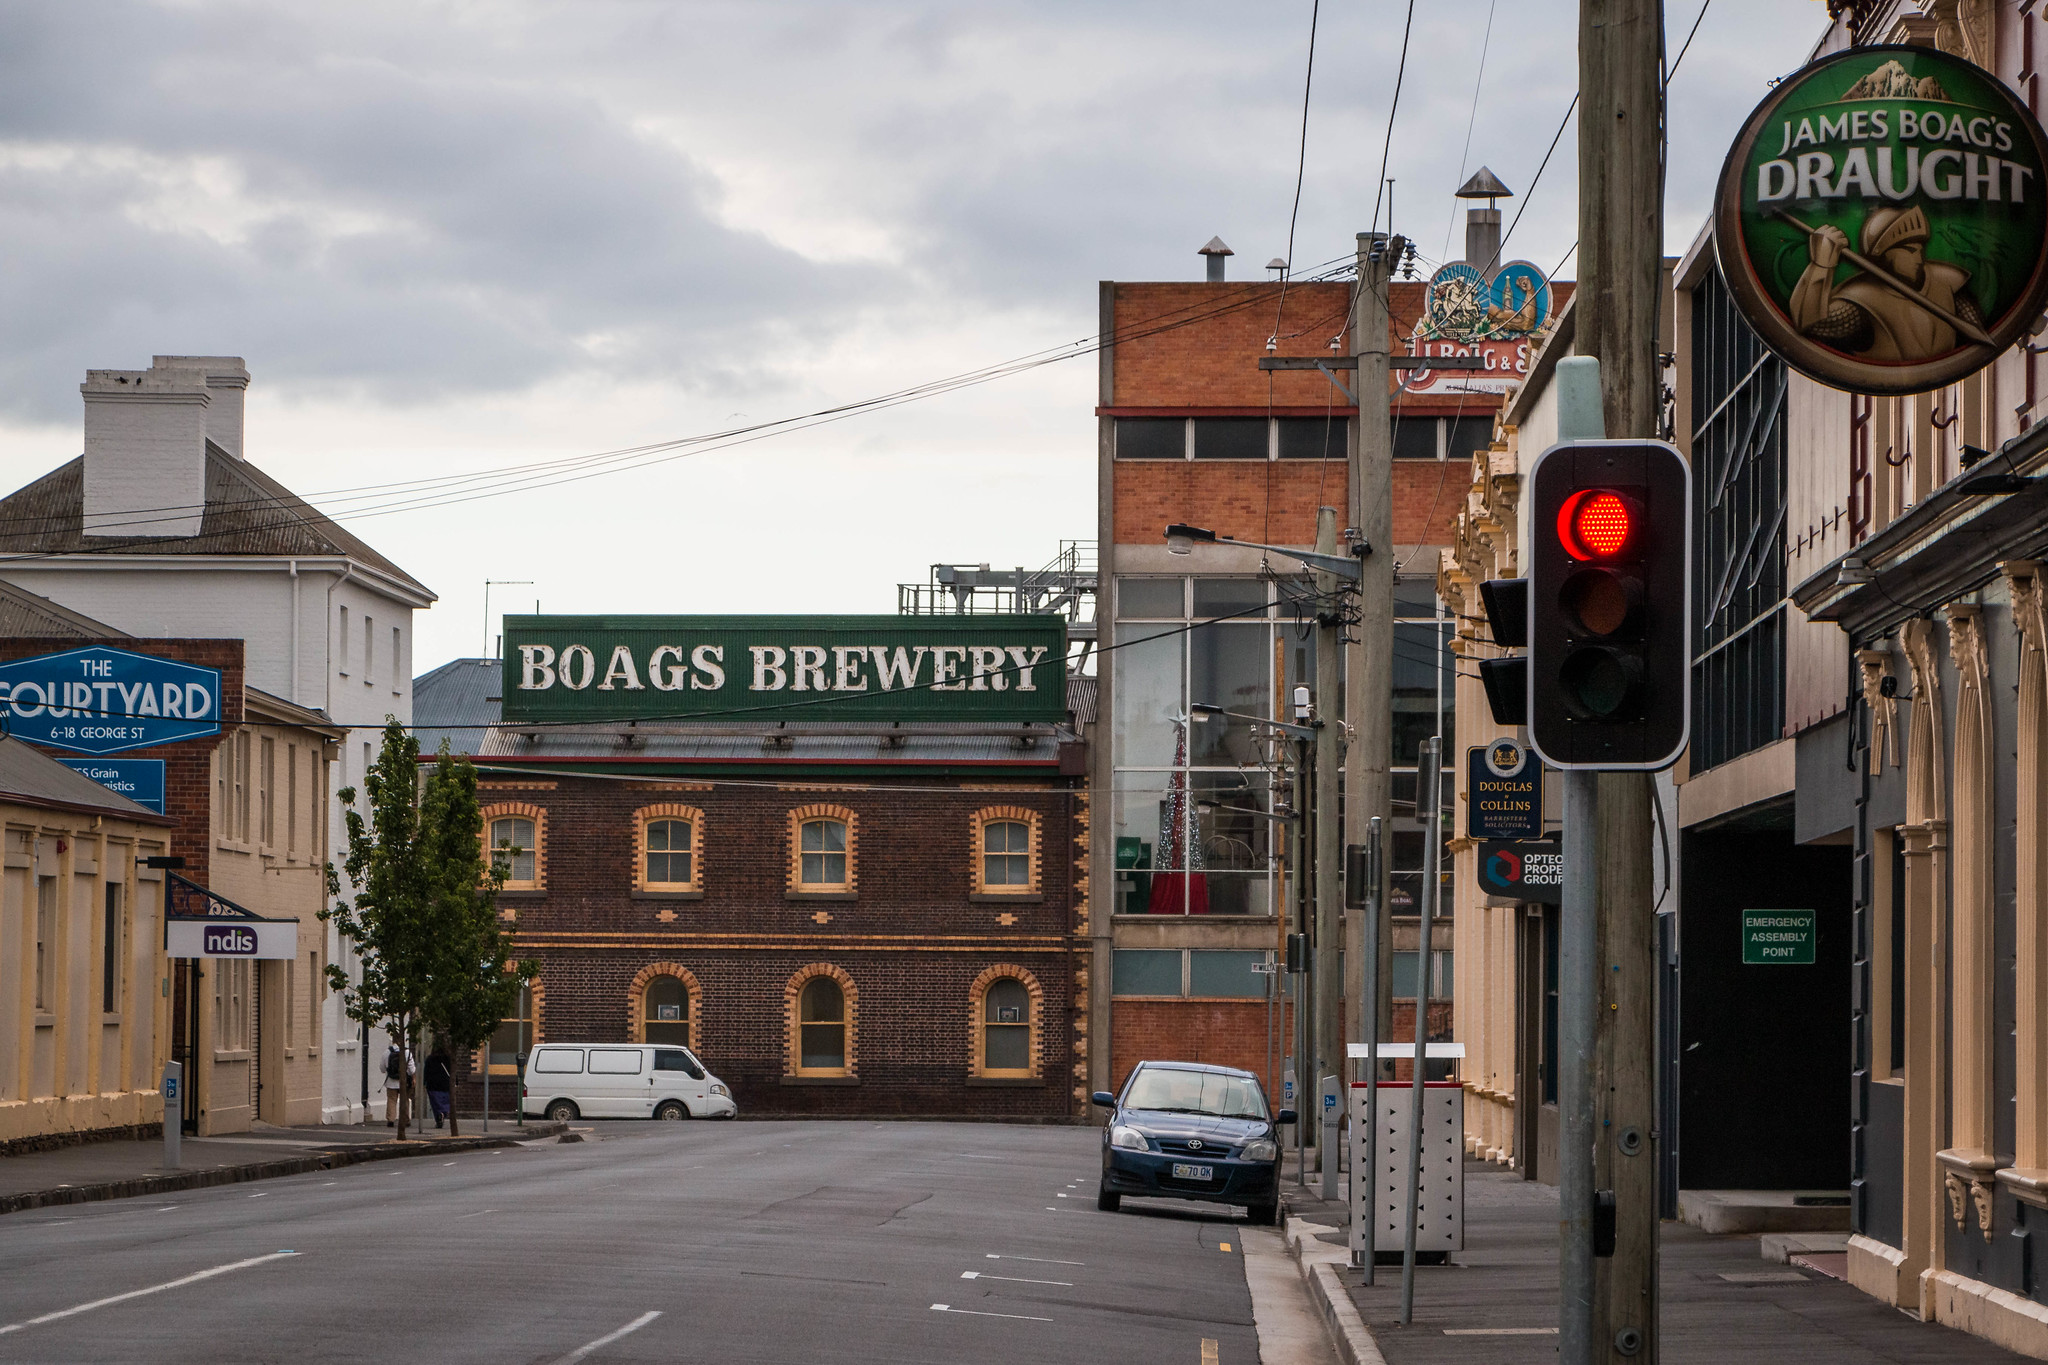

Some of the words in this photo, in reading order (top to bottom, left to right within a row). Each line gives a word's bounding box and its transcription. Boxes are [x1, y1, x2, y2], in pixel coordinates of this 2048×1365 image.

[1778, 109, 1888, 157] JAMES
[1899, 109, 2013, 152] BOAG'S
[1757, 146, 2034, 203] DRAUGHT
[80, 659, 112, 677] THE
[516, 644, 725, 692] BOAGS
[748, 645, 1049, 692] BREWERY
[50, 727, 76, 739] 6-18
[80, 727, 127, 739] GEORGE
[131, 727, 145, 739] ST
[90, 768, 119, 778] Grain
[1479, 781, 1533, 792] DOUGLAS
[1480, 801, 1531, 811] COLLINS
[1524, 864, 1563, 874] PROPE
[1745, 917, 1812, 927] EMERGENCY
[207, 929, 253, 952] ndis
[1751, 932, 1807, 942] ASSEMBLY
[1762, 947, 1796, 957] POINT
